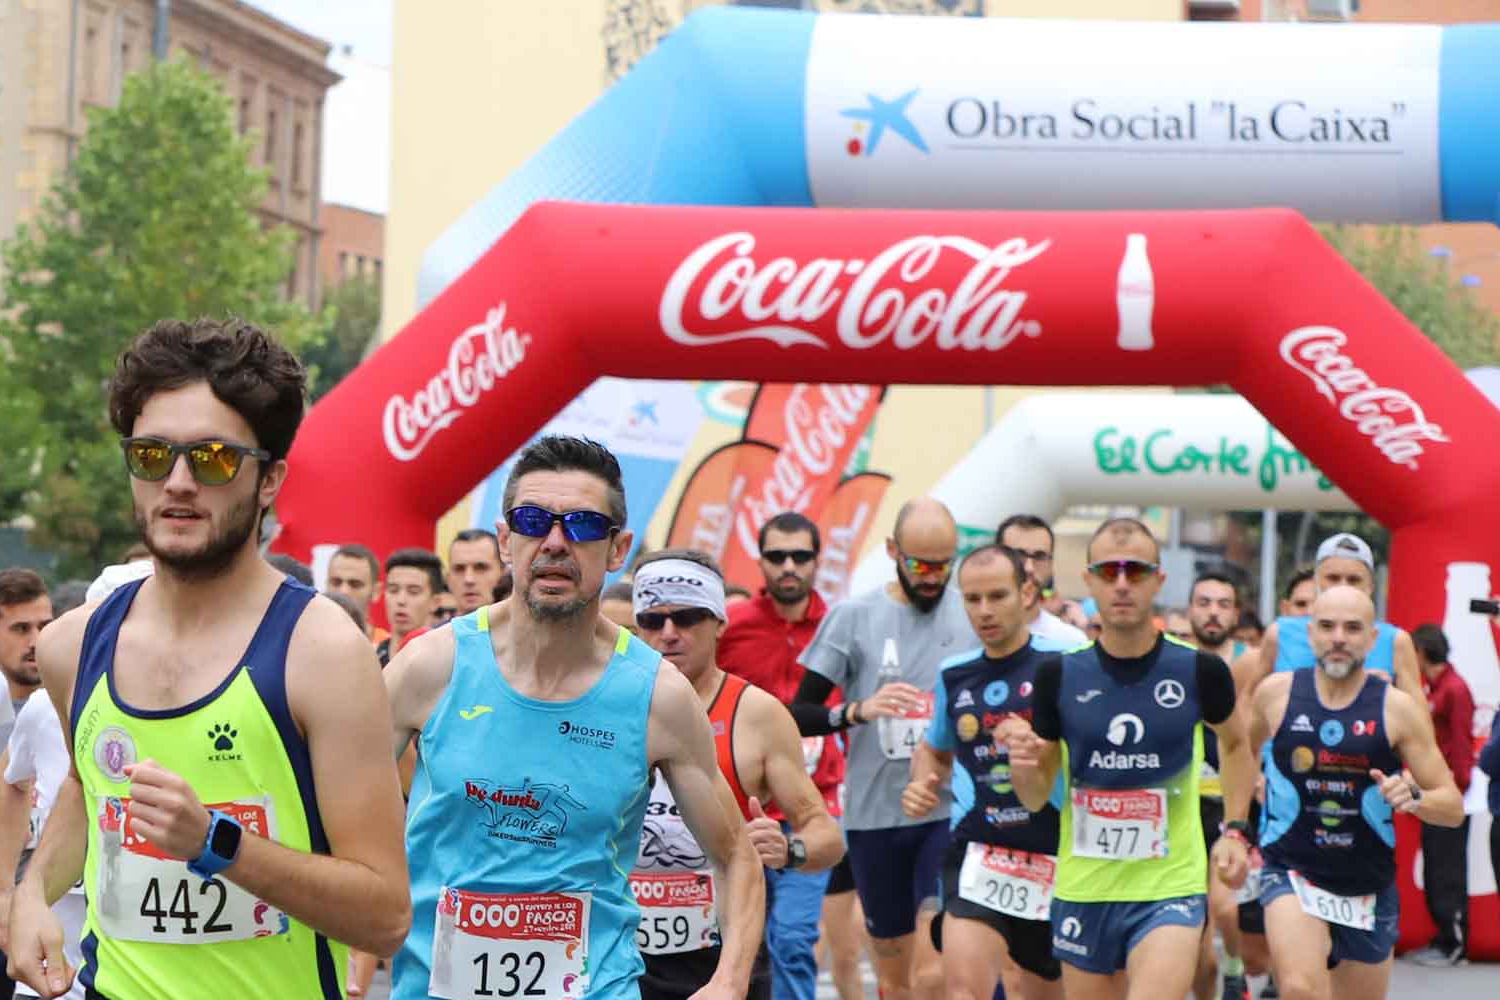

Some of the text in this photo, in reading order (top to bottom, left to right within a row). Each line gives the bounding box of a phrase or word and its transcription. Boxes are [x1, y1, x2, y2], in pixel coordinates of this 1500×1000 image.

[945, 97, 1058, 140] Obra
[1070, 99, 1198, 142] Social
[659, 231, 1052, 350] Coca-Cola
[383, 300, 529, 461] Coca-Cola
[1279, 326, 1452, 468] Coca-Cola
[1094, 425, 1140, 475] El
[1145, 428, 1251, 475] Corte
[571, 725, 616, 741] HOSPES
[208, 753, 243, 761] KELME
[1089, 750, 1161, 770] Adarsa
[1096, 826, 1140, 854] 477
[140, 876, 233, 934] 442
[630, 881, 665, 899] 000
[984, 879, 1030, 913] 203
[526, 910, 577, 925] PASOS
[1317, 895, 1353, 922] 610
[473, 951, 546, 997] 132
